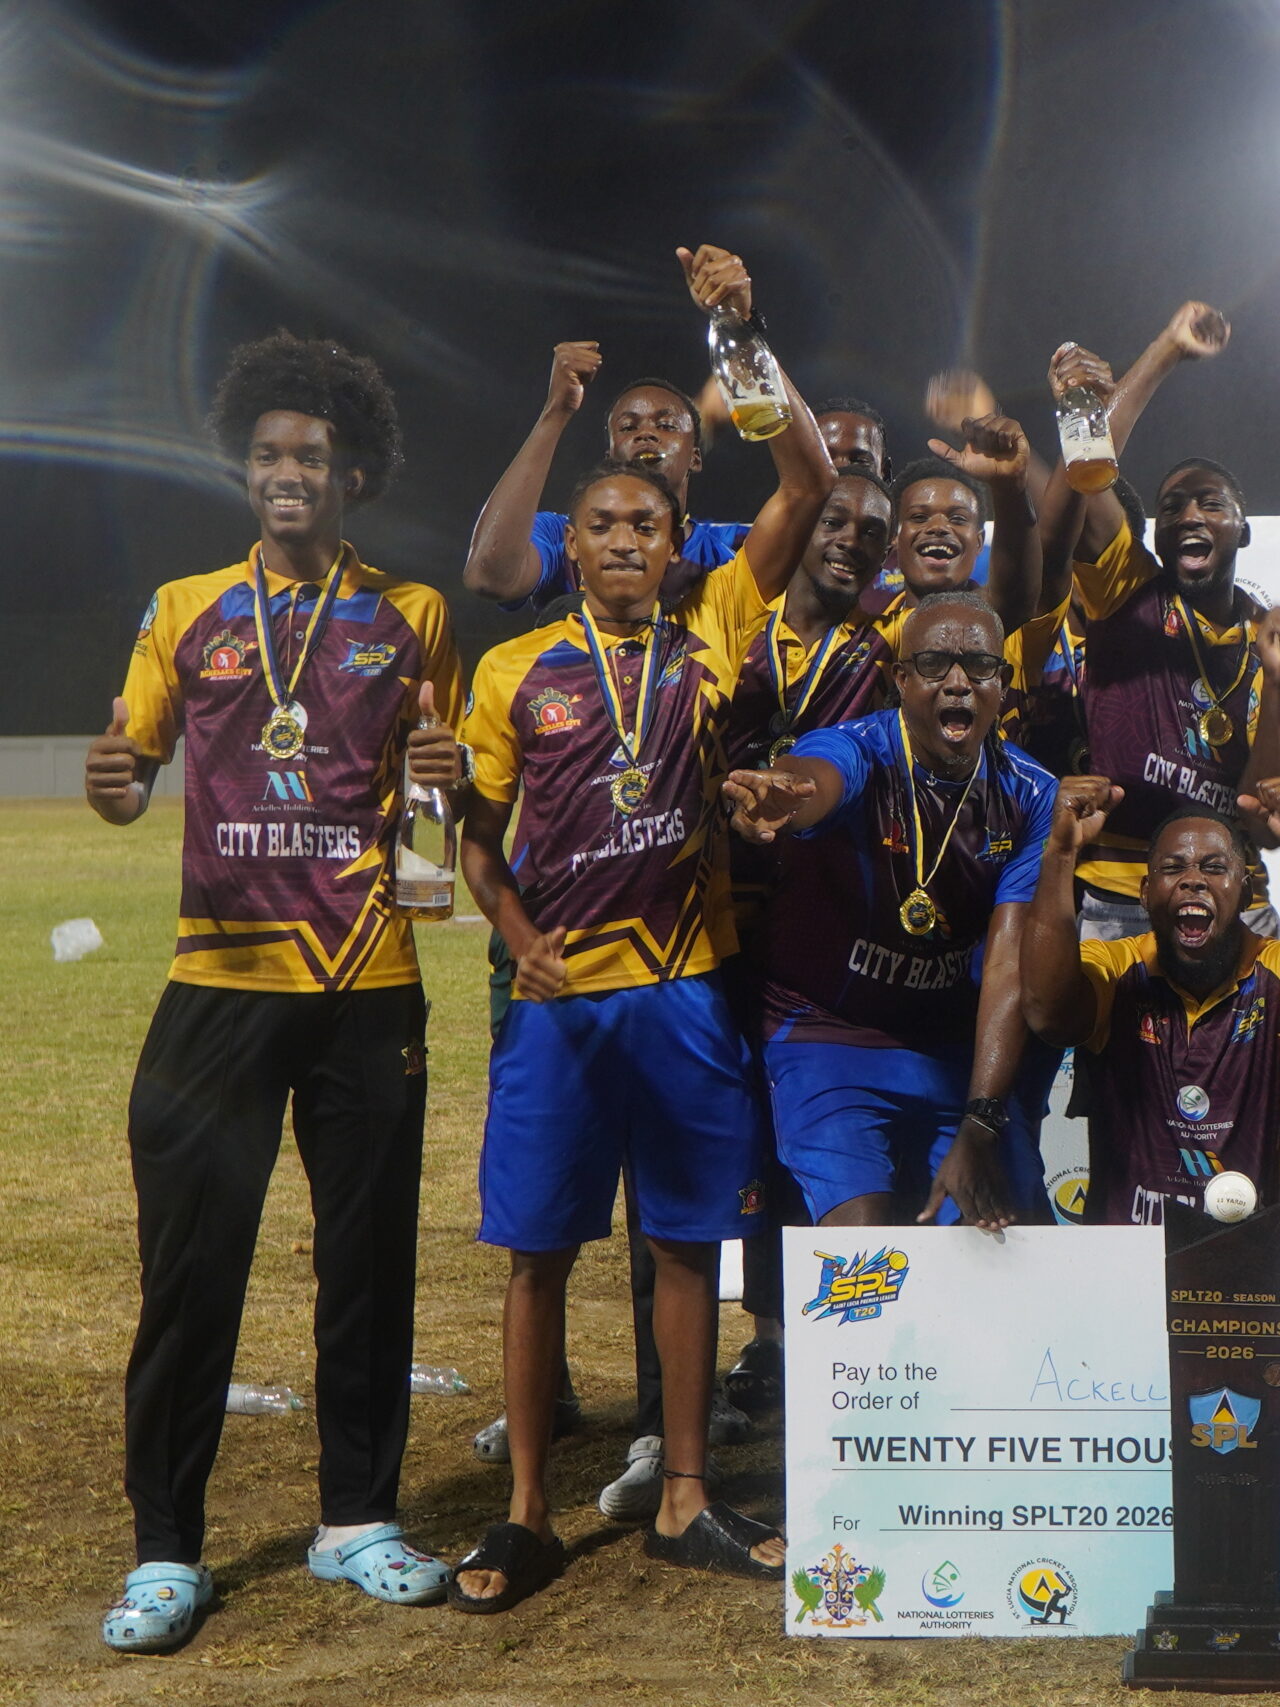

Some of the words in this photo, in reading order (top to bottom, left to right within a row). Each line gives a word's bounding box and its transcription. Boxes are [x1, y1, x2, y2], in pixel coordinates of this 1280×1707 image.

[1235, 577, 1261, 590] RICKET
[353, 652, 391, 665] SPL
[217, 823, 261, 857] CITY
[267, 823, 361, 859] BLASTERS
[848, 938, 905, 985] CITY
[1196, 1120, 1234, 1131] LOTTERIES
[1046, 1168, 1072, 1190] TIONAL
[1131, 1184, 1170, 1225] CIT
[830, 1272, 898, 1303] SPL
[1171, 1290, 1222, 1303] SPLT20
[1233, 1294, 1276, 1303] SEASON
[860, 1297, 879, 1306] PREMIER
[879, 1294, 897, 1302] LEAGUE
[853, 1306, 876, 1318] T20
[1206, 1346, 1255, 1360] 2026
[832, 1362, 870, 1385] Pay
[878, 1364, 897, 1381] to
[904, 1362, 938, 1381] the
[1030, 1347, 1168, 1402] ACKELL
[832, 1391, 893, 1410] Order
[900, 1391, 920, 1410] of
[1190, 1423, 1258, 1448] SPL
[832, 1436, 976, 1463] TWENTY
[988, 1436, 1062, 1463] FIVE
[1069, 1437, 1173, 1464] THOU
[832, 1515, 861, 1531] For
[898, 1505, 1004, 1530] Winning
[1012, 1505, 1108, 1527] SPLT20
[1116, 1506, 1174, 1528] 2026
[1008, 1559, 1035, 1586] NATIONAL
[1036, 1557, 1066, 1570] CRICKET
[1006, 1588, 1014, 1610] LUCIA
[1065, 1570, 1079, 1617] ASSOCIATION
[897, 1611, 944, 1620] NATIONAL
[946, 1611, 995, 1620] LOTTERIES
[920, 1621, 972, 1630] AUTHORITY
